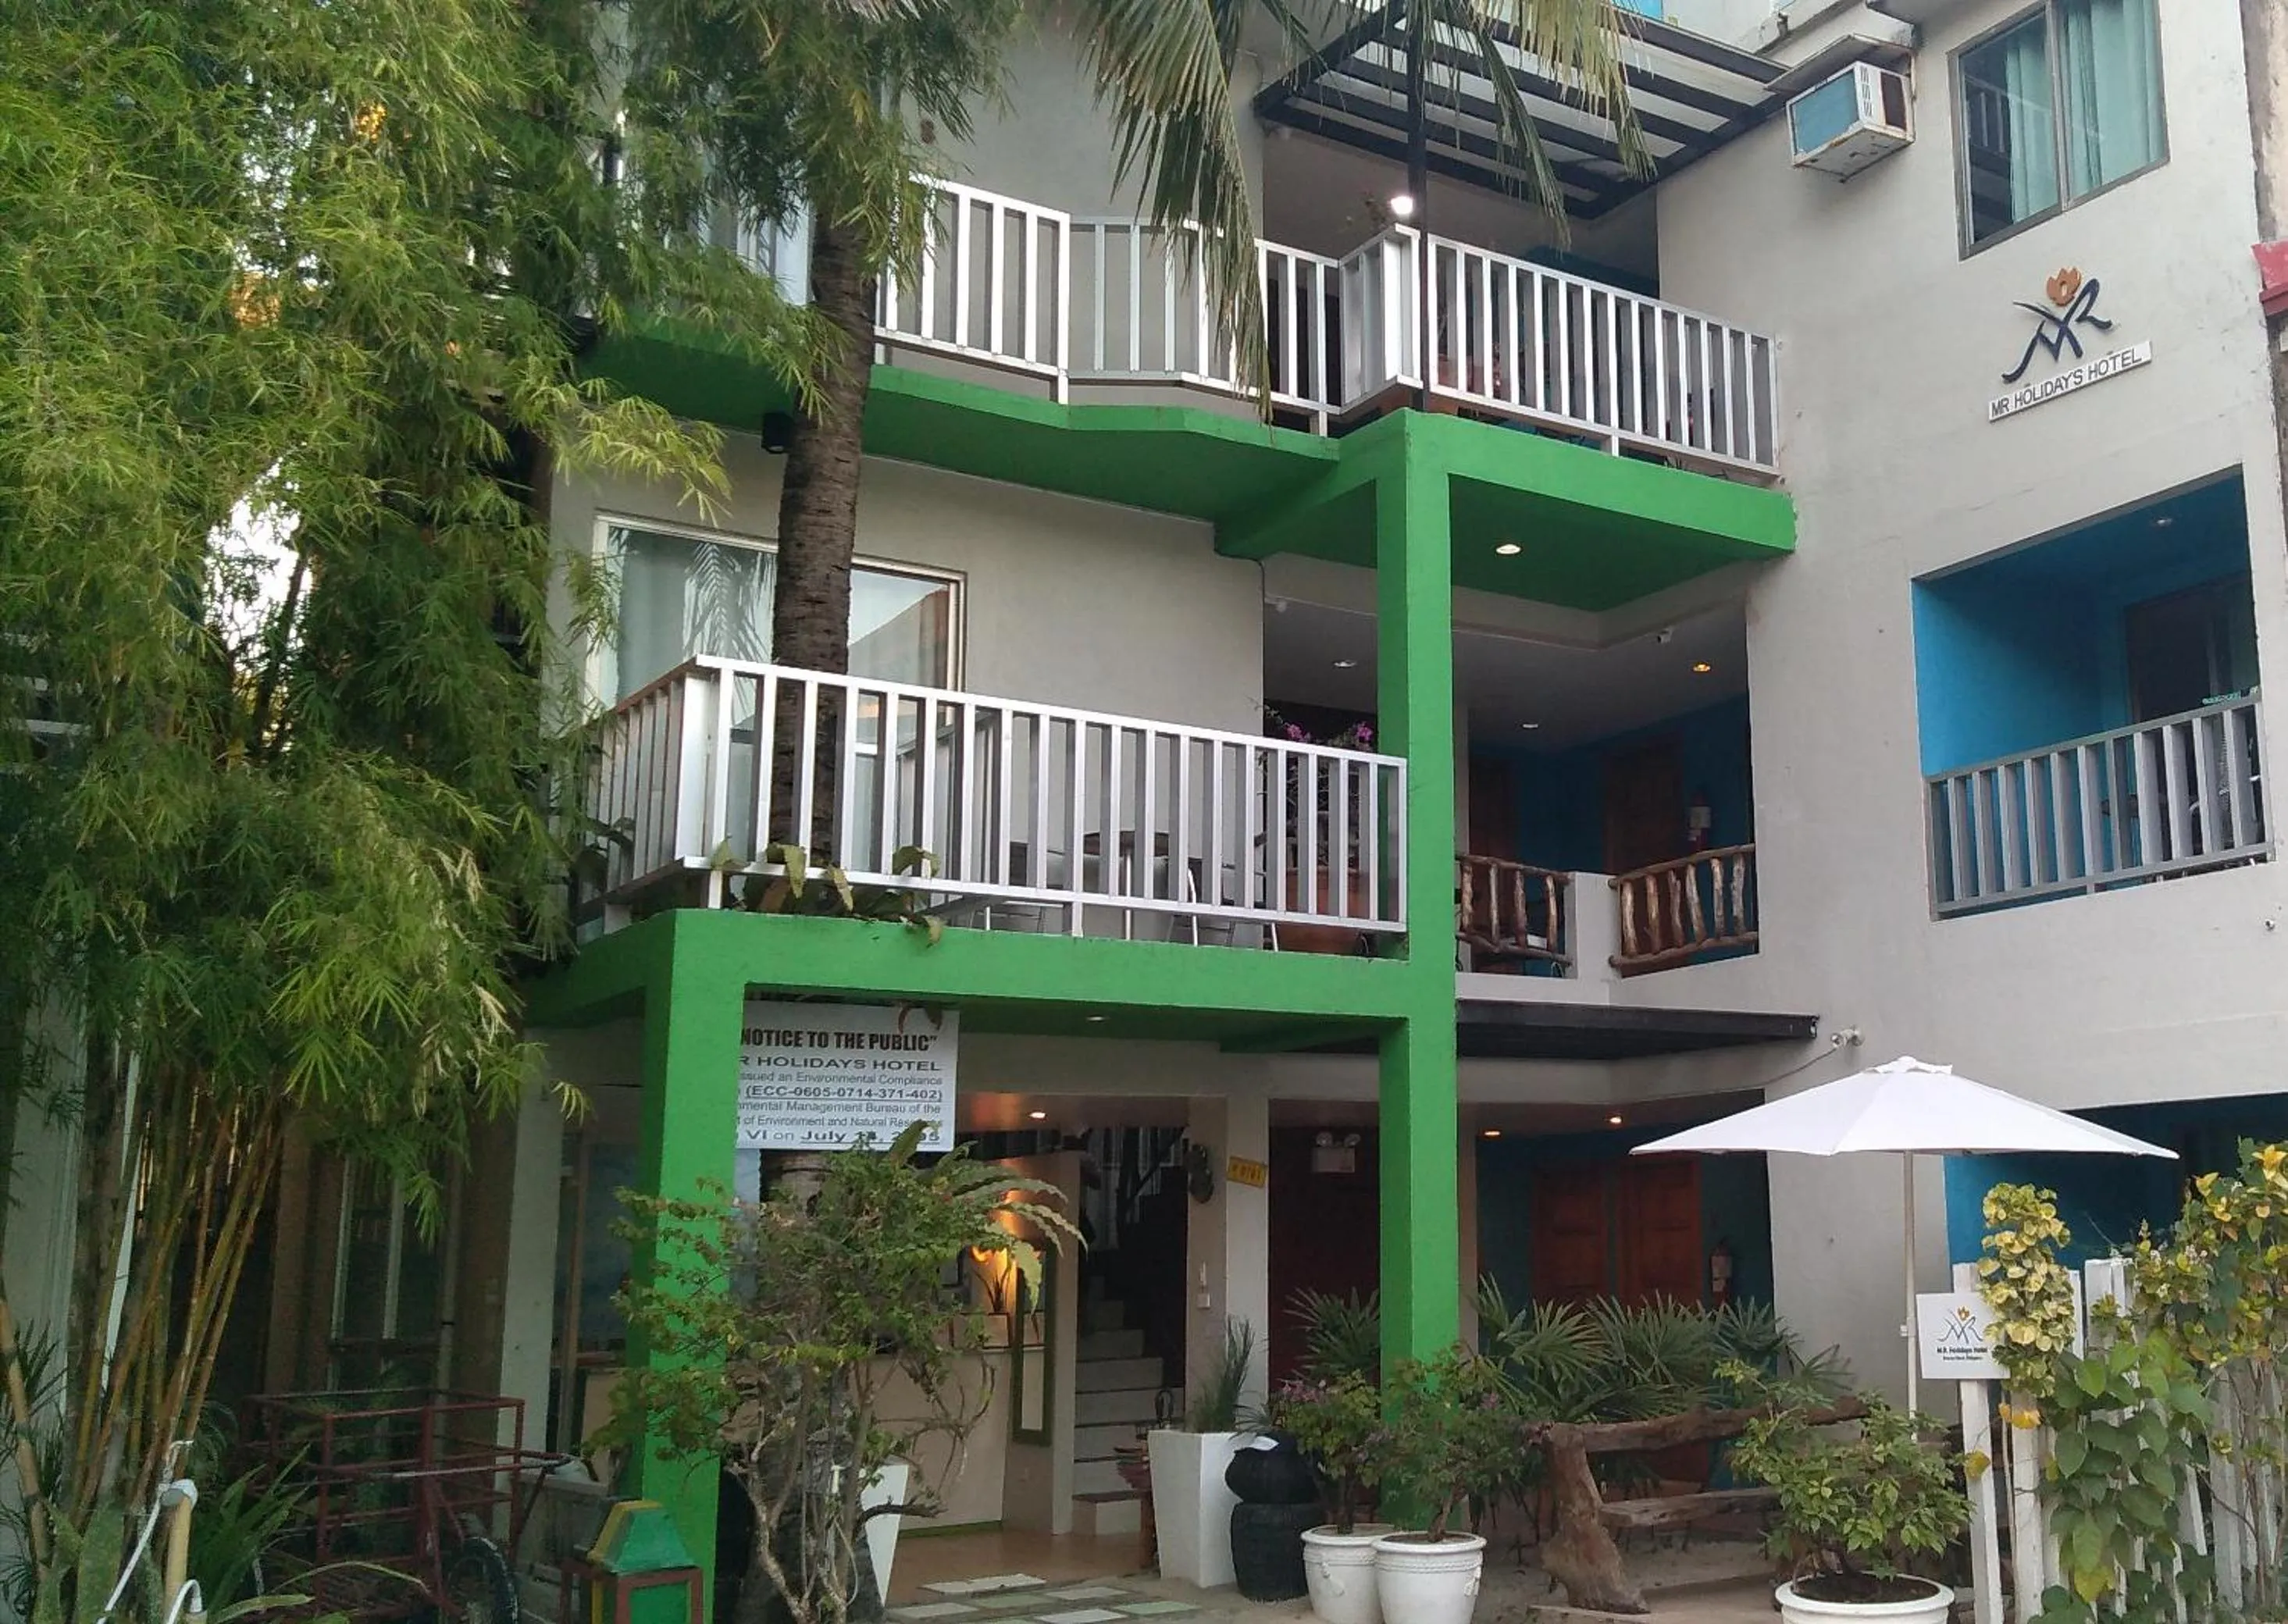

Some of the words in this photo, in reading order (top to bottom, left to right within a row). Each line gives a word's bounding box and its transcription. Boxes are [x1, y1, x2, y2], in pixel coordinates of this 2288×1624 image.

[1991, 397, 2010, 417] MR
[2088, 347, 2142, 380] HOTEL
[807, 1031, 829, 1048] TO
[834, 1031, 866, 1049] THE
[757, 1056, 866, 1070] HOLIDAYS
[873, 1060, 942, 1071] HOTEL
[797, 1072, 875, 1084] Environmental
[879, 1074, 943, 1085] Compliance
[786, 1102, 862, 1113] Management
[866, 1102, 906, 1113] Bureau
[909, 1103, 920, 1113] of
[924, 1104, 941, 1113] the
[744, 1116, 755, 1125] of
[757, 1116, 824, 1126] Environment
[828, 1117, 847, 1126] and
[850, 1117, 886, 1126] Natural
[800, 1131, 846, 1142] July
